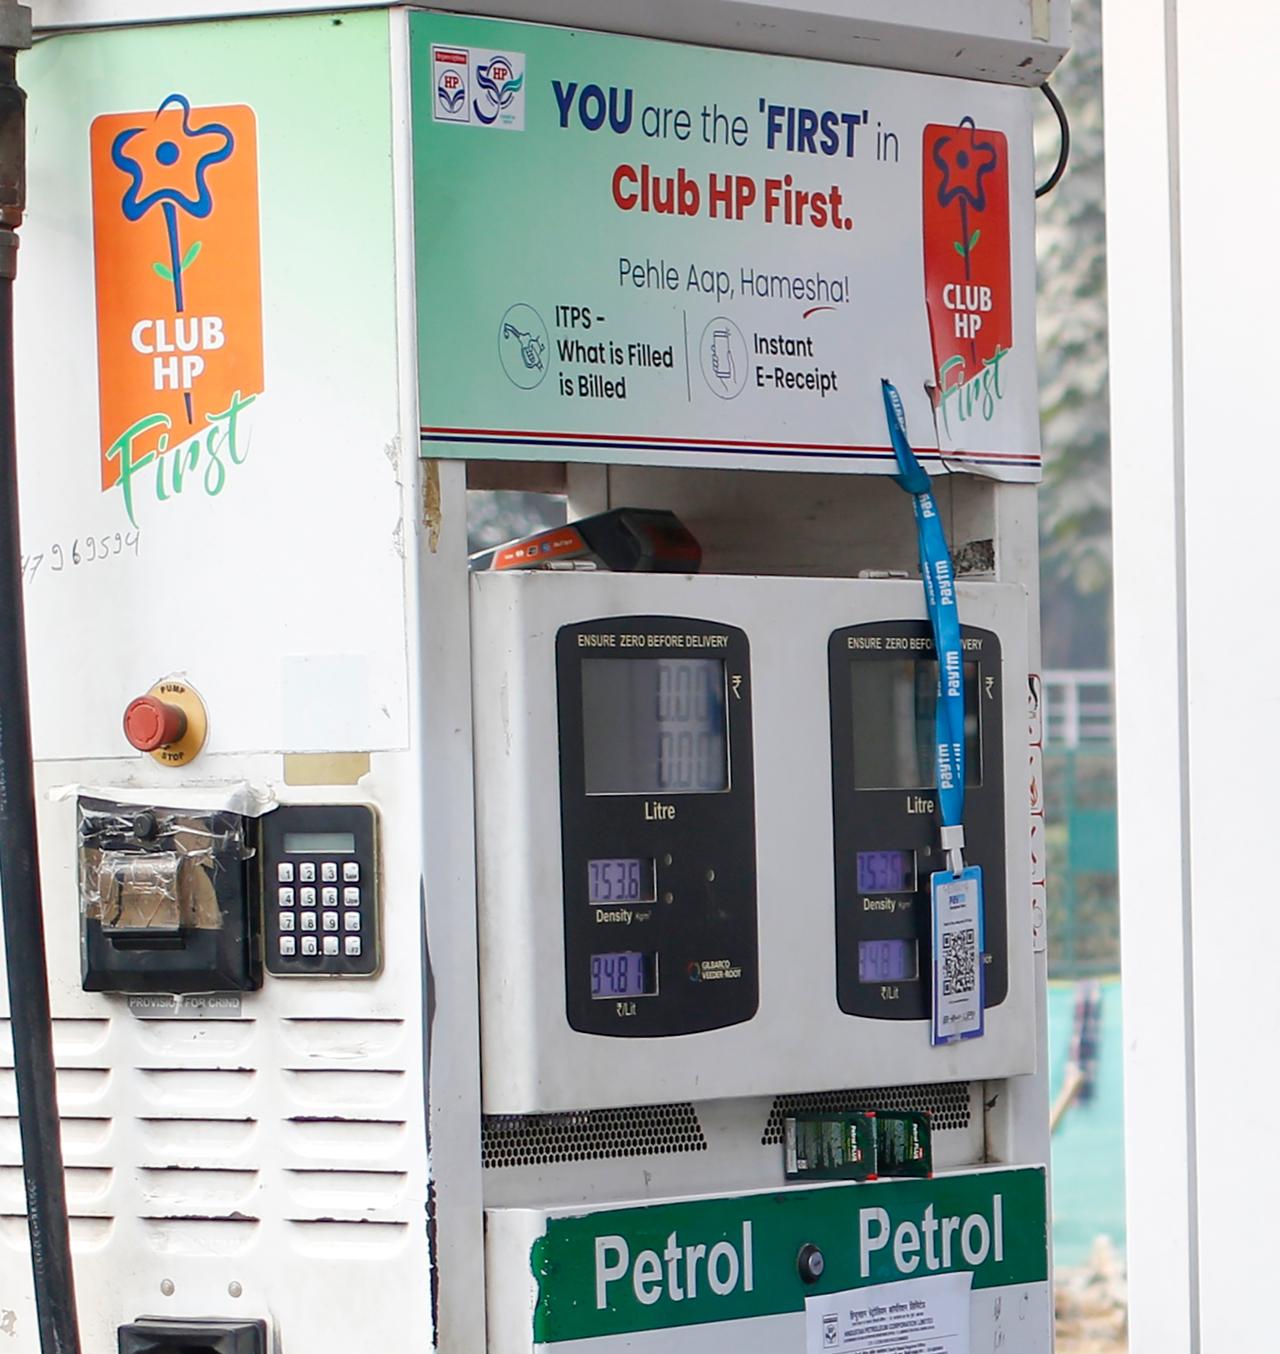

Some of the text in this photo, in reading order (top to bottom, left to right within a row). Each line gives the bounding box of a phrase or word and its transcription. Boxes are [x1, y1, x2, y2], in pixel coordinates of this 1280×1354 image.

[444, 76, 459, 90] HP
[493, 67, 508, 81] HP
[552, 80, 899, 162] YOU are the 'FIRST' in
[611, 164, 854, 231] Club HP First.
[619, 258, 850, 303] Pehle Aap, Hamesha!
[943, 283, 992, 311] CLUB
[555, 305, 592, 329] ITPS
[954, 313, 983, 338] HP
[131, 316, 225, 354] CLUB
[754, 333, 813, 357] Instant
[556, 340, 673, 368] What is Filled
[153, 355, 205, 390] HP
[559, 372, 626, 399] is Billed
[756, 366, 837, 397] E-Receipt
[939, 344, 1009, 441] First
[105, 389, 257, 529] First
[577, 634, 729, 648] ENSURE ZERO BEFORE DELIVERY
[848, 637, 882, 649] ENSURE
[885, 637, 908, 650] ZERO
[160, 684, 185, 694] PUMP
[731, 674, 742, 700] ₹
[161, 752, 184, 761] STOP
[645, 801, 676, 820] Litre
[907, 796, 934, 814] Litre
[596, 908, 633, 925] Density
[863, 898, 896, 912] Density
[858, 1194, 1003, 1278] Petrol
[595, 1220, 754, 1310] Petrol
